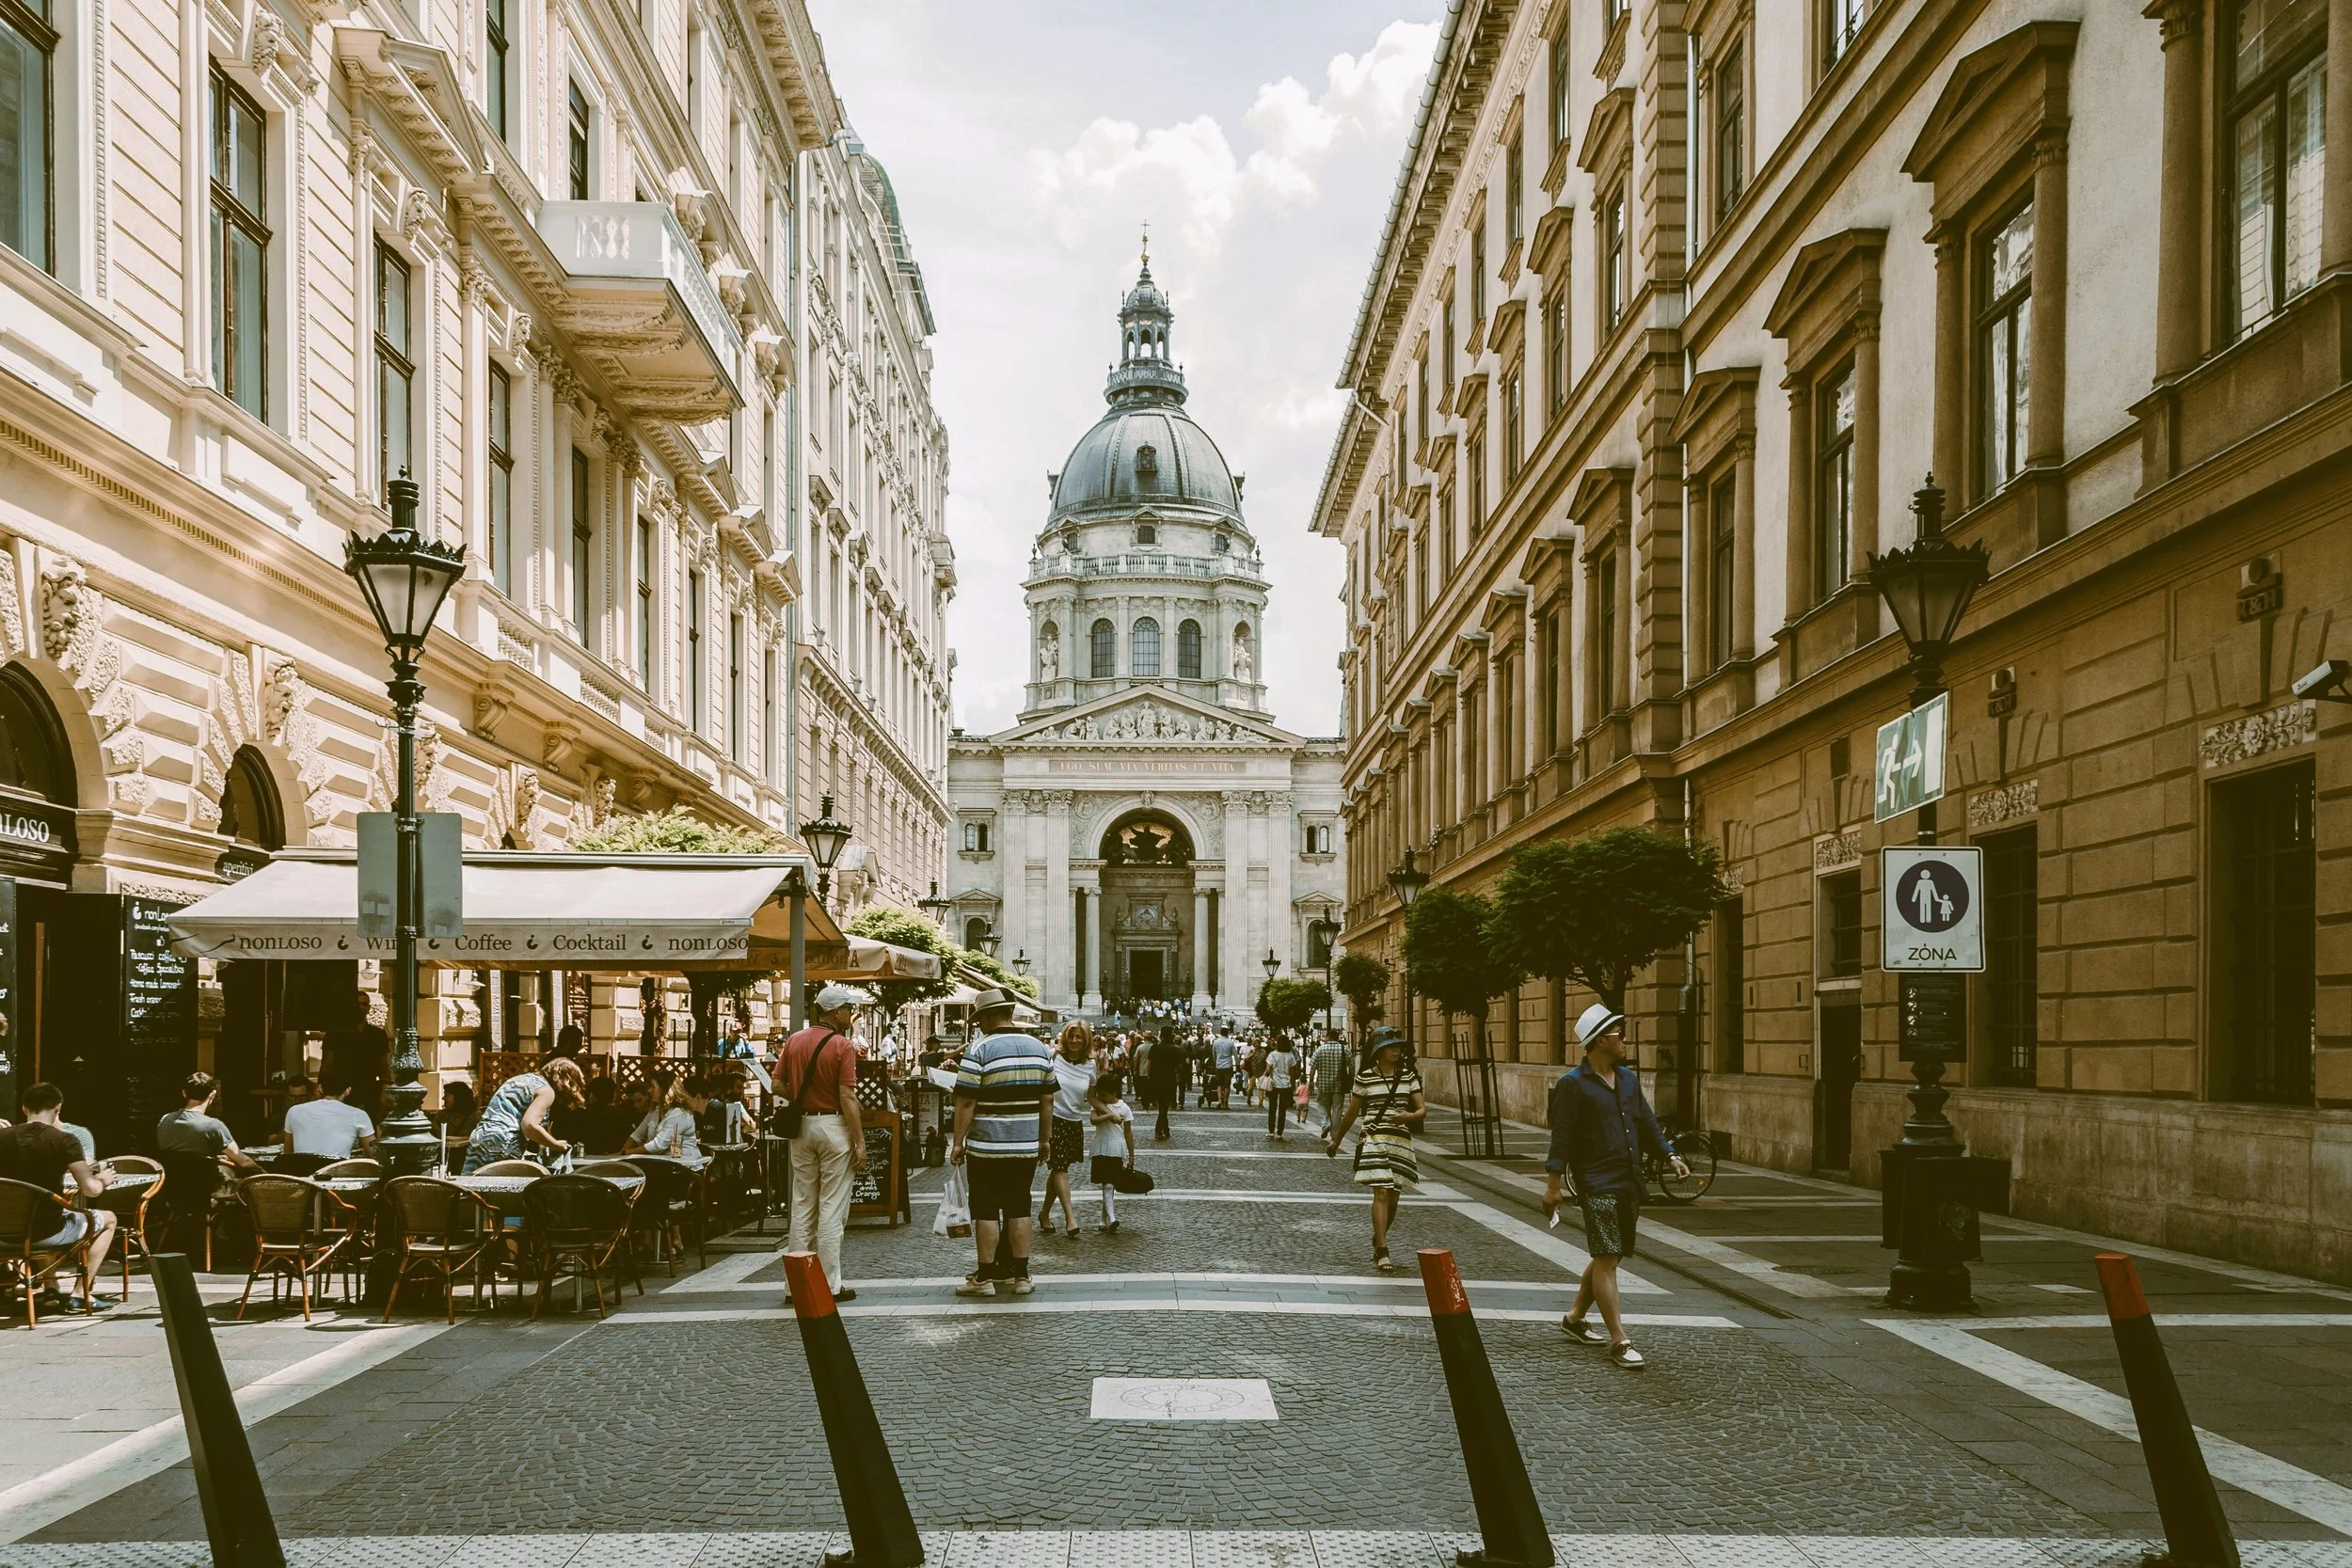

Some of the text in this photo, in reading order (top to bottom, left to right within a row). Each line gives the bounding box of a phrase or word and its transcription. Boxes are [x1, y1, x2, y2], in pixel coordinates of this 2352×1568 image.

[1060, 763, 1234, 771] EGO SUM VIA VERITAS ET VITA
[0, 813, 50, 843] LOSO
[454, 933, 513, 951] Coffee
[552, 933, 627, 951] Cocktail
[1908, 943, 1957, 960] ZÓNA
[855, 1191, 881, 1200] Orange
